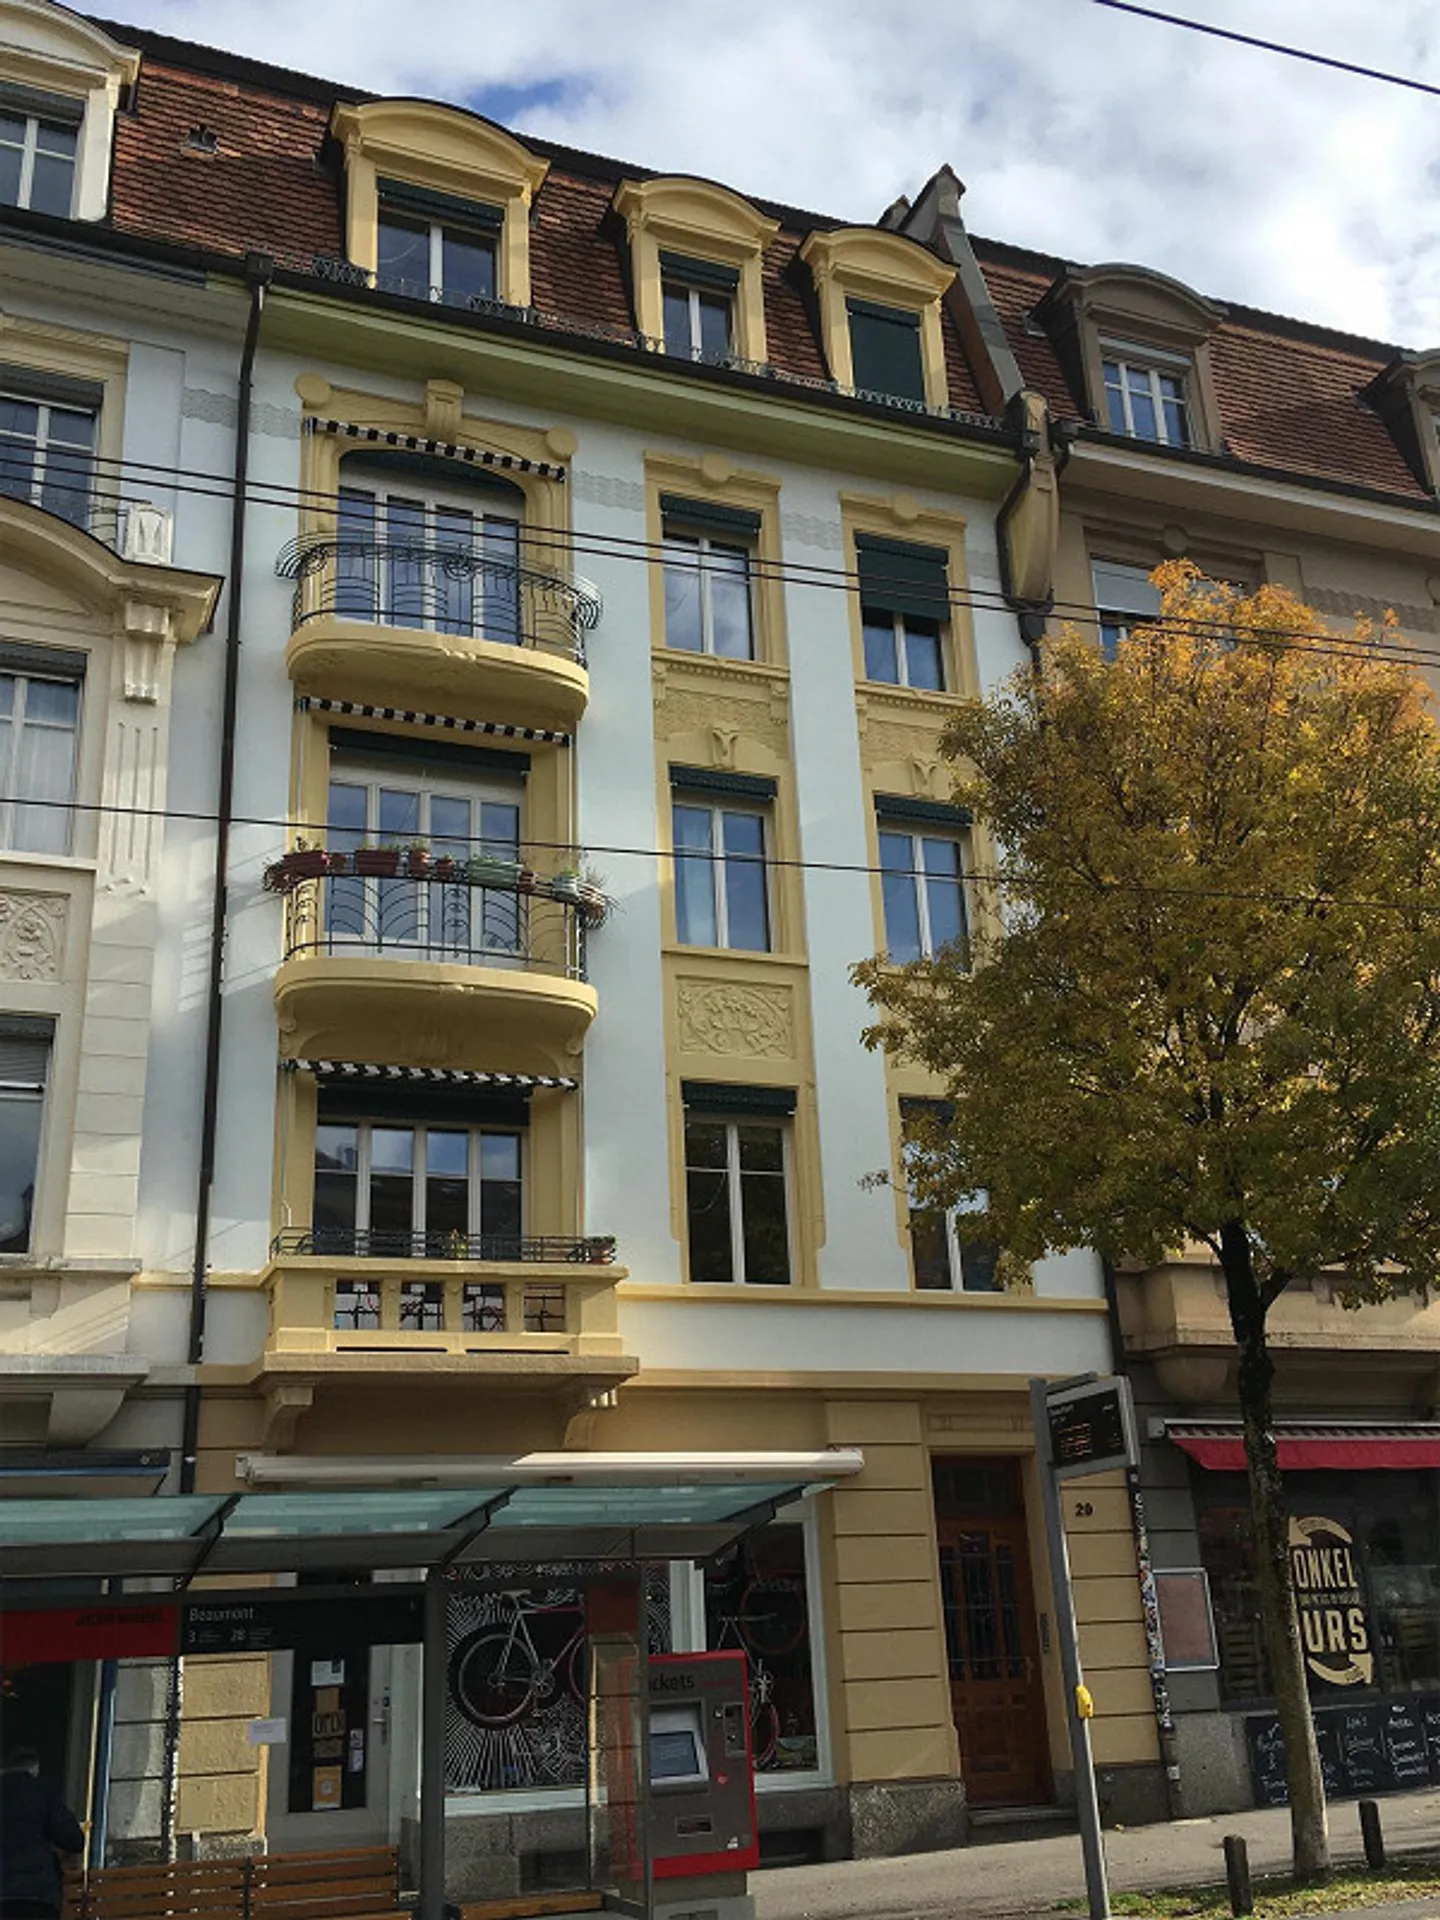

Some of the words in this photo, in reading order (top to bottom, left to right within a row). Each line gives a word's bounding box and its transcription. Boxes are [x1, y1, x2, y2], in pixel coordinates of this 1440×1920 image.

[1292, 1547, 1359, 1588] ONKEL
[188, 1606, 254, 1622] Beaumont
[188, 1628, 197, 1643] 3
[1302, 1607, 1368, 1653] URS
[648, 1672, 695, 1692] ickets
